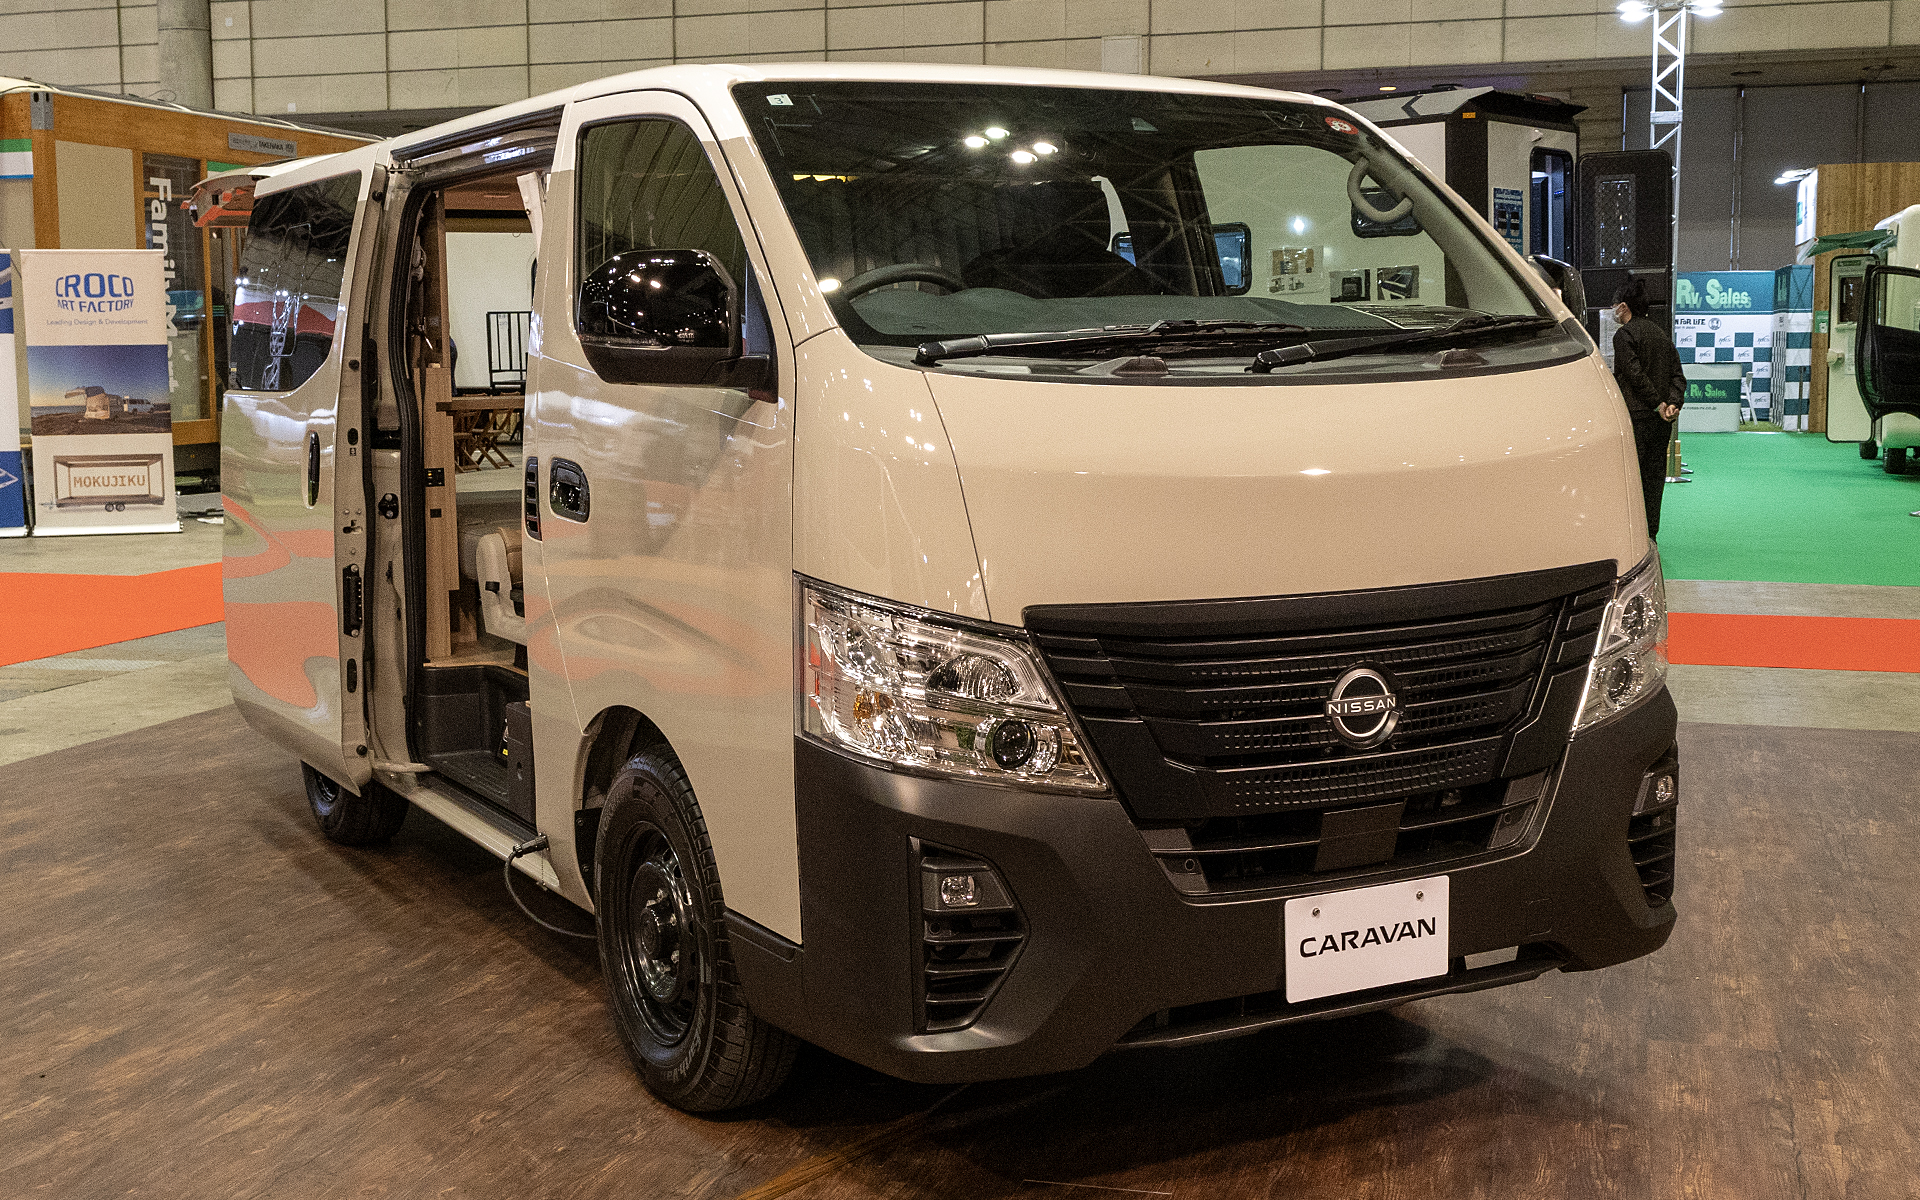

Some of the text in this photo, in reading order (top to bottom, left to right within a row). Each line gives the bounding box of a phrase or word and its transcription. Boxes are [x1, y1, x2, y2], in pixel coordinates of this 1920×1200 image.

[55, 273, 134, 298] CROCO
[1705, 279, 1751, 309] Sales
[79, 299, 134, 313] FACTORY
[1705, 383, 1728, 399] Sales
[73, 475, 146, 488] MOKUJIKU
[1328, 697, 1396, 715] NISSAN
[1300, 916, 1436, 958] CARAVAN
